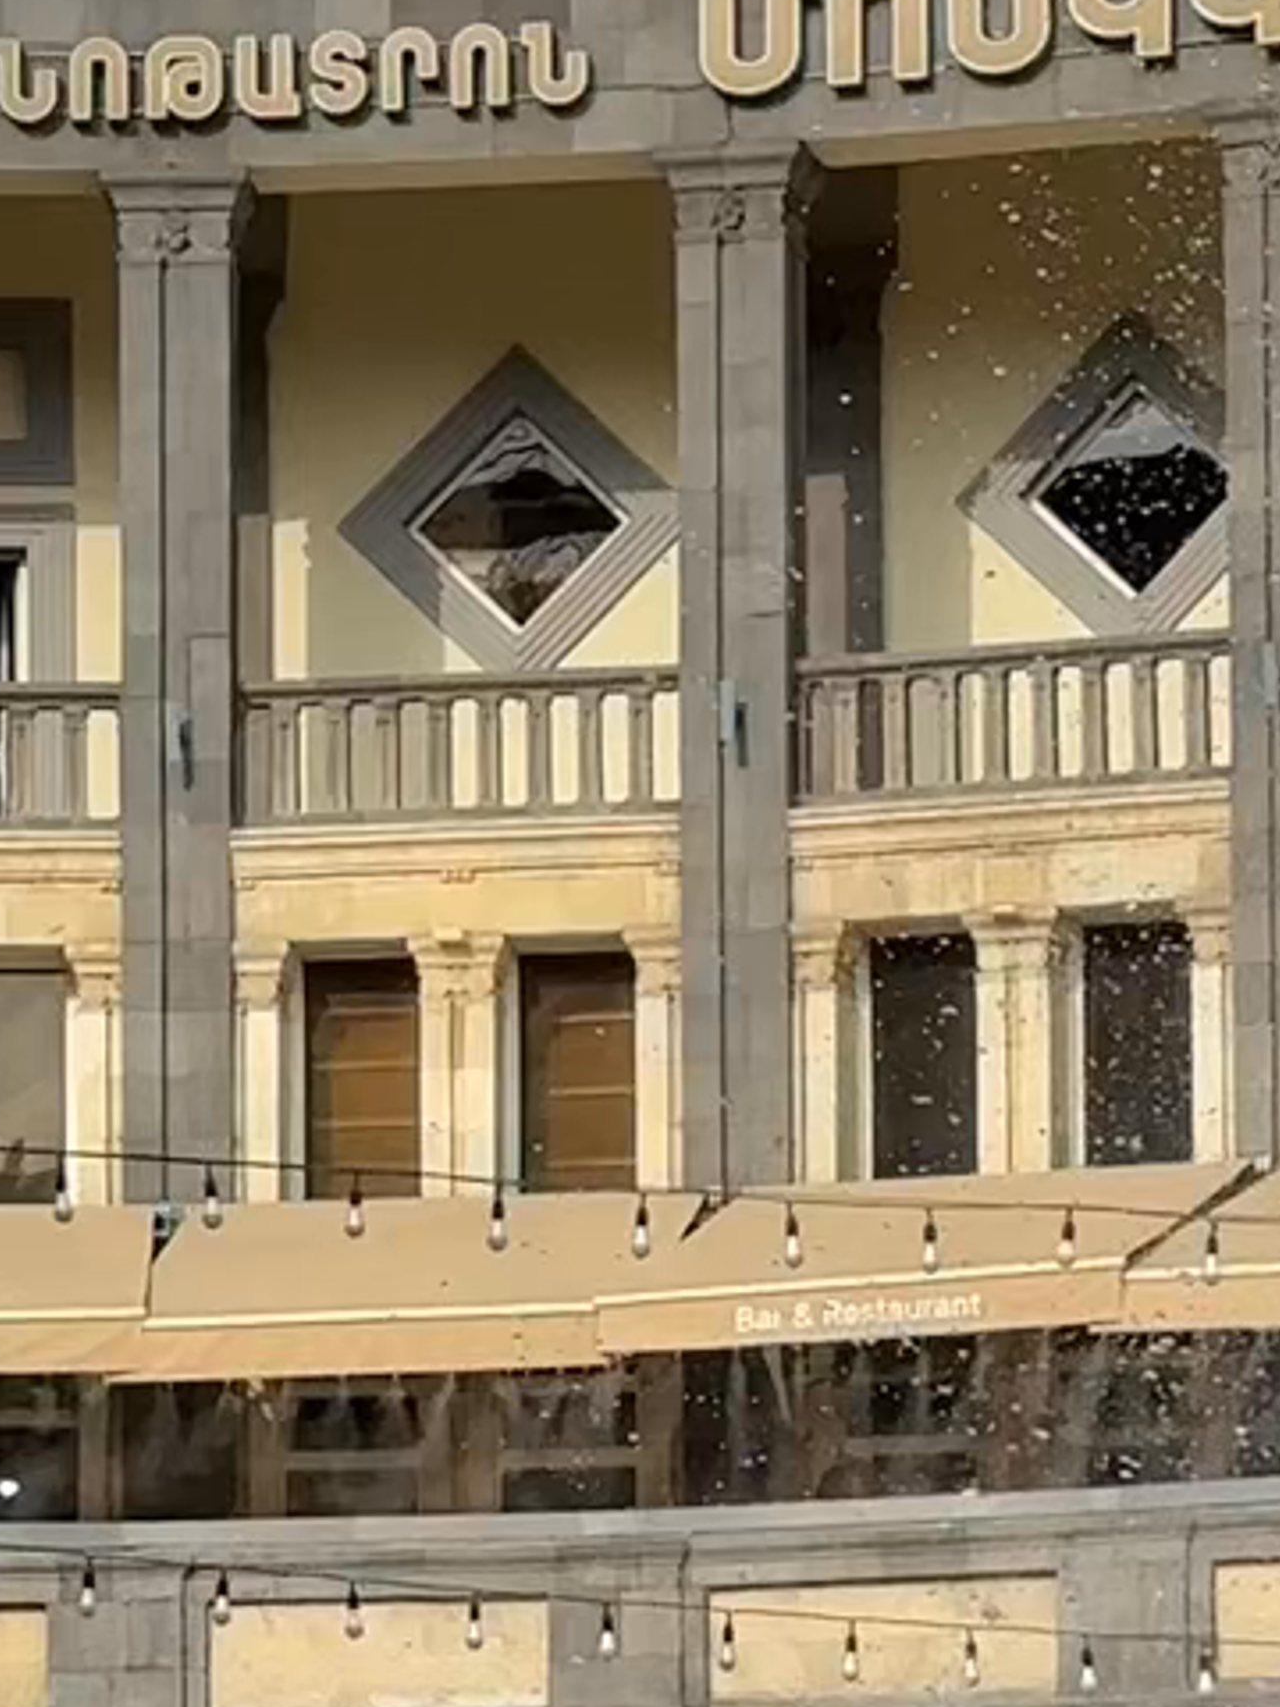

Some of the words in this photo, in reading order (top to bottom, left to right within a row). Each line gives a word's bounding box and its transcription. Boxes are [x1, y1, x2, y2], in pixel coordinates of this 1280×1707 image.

[736, 1305, 781, 1333] Bar
[794, 1302, 814, 1328] &
[822, 1293, 982, 1327] Restaurant
